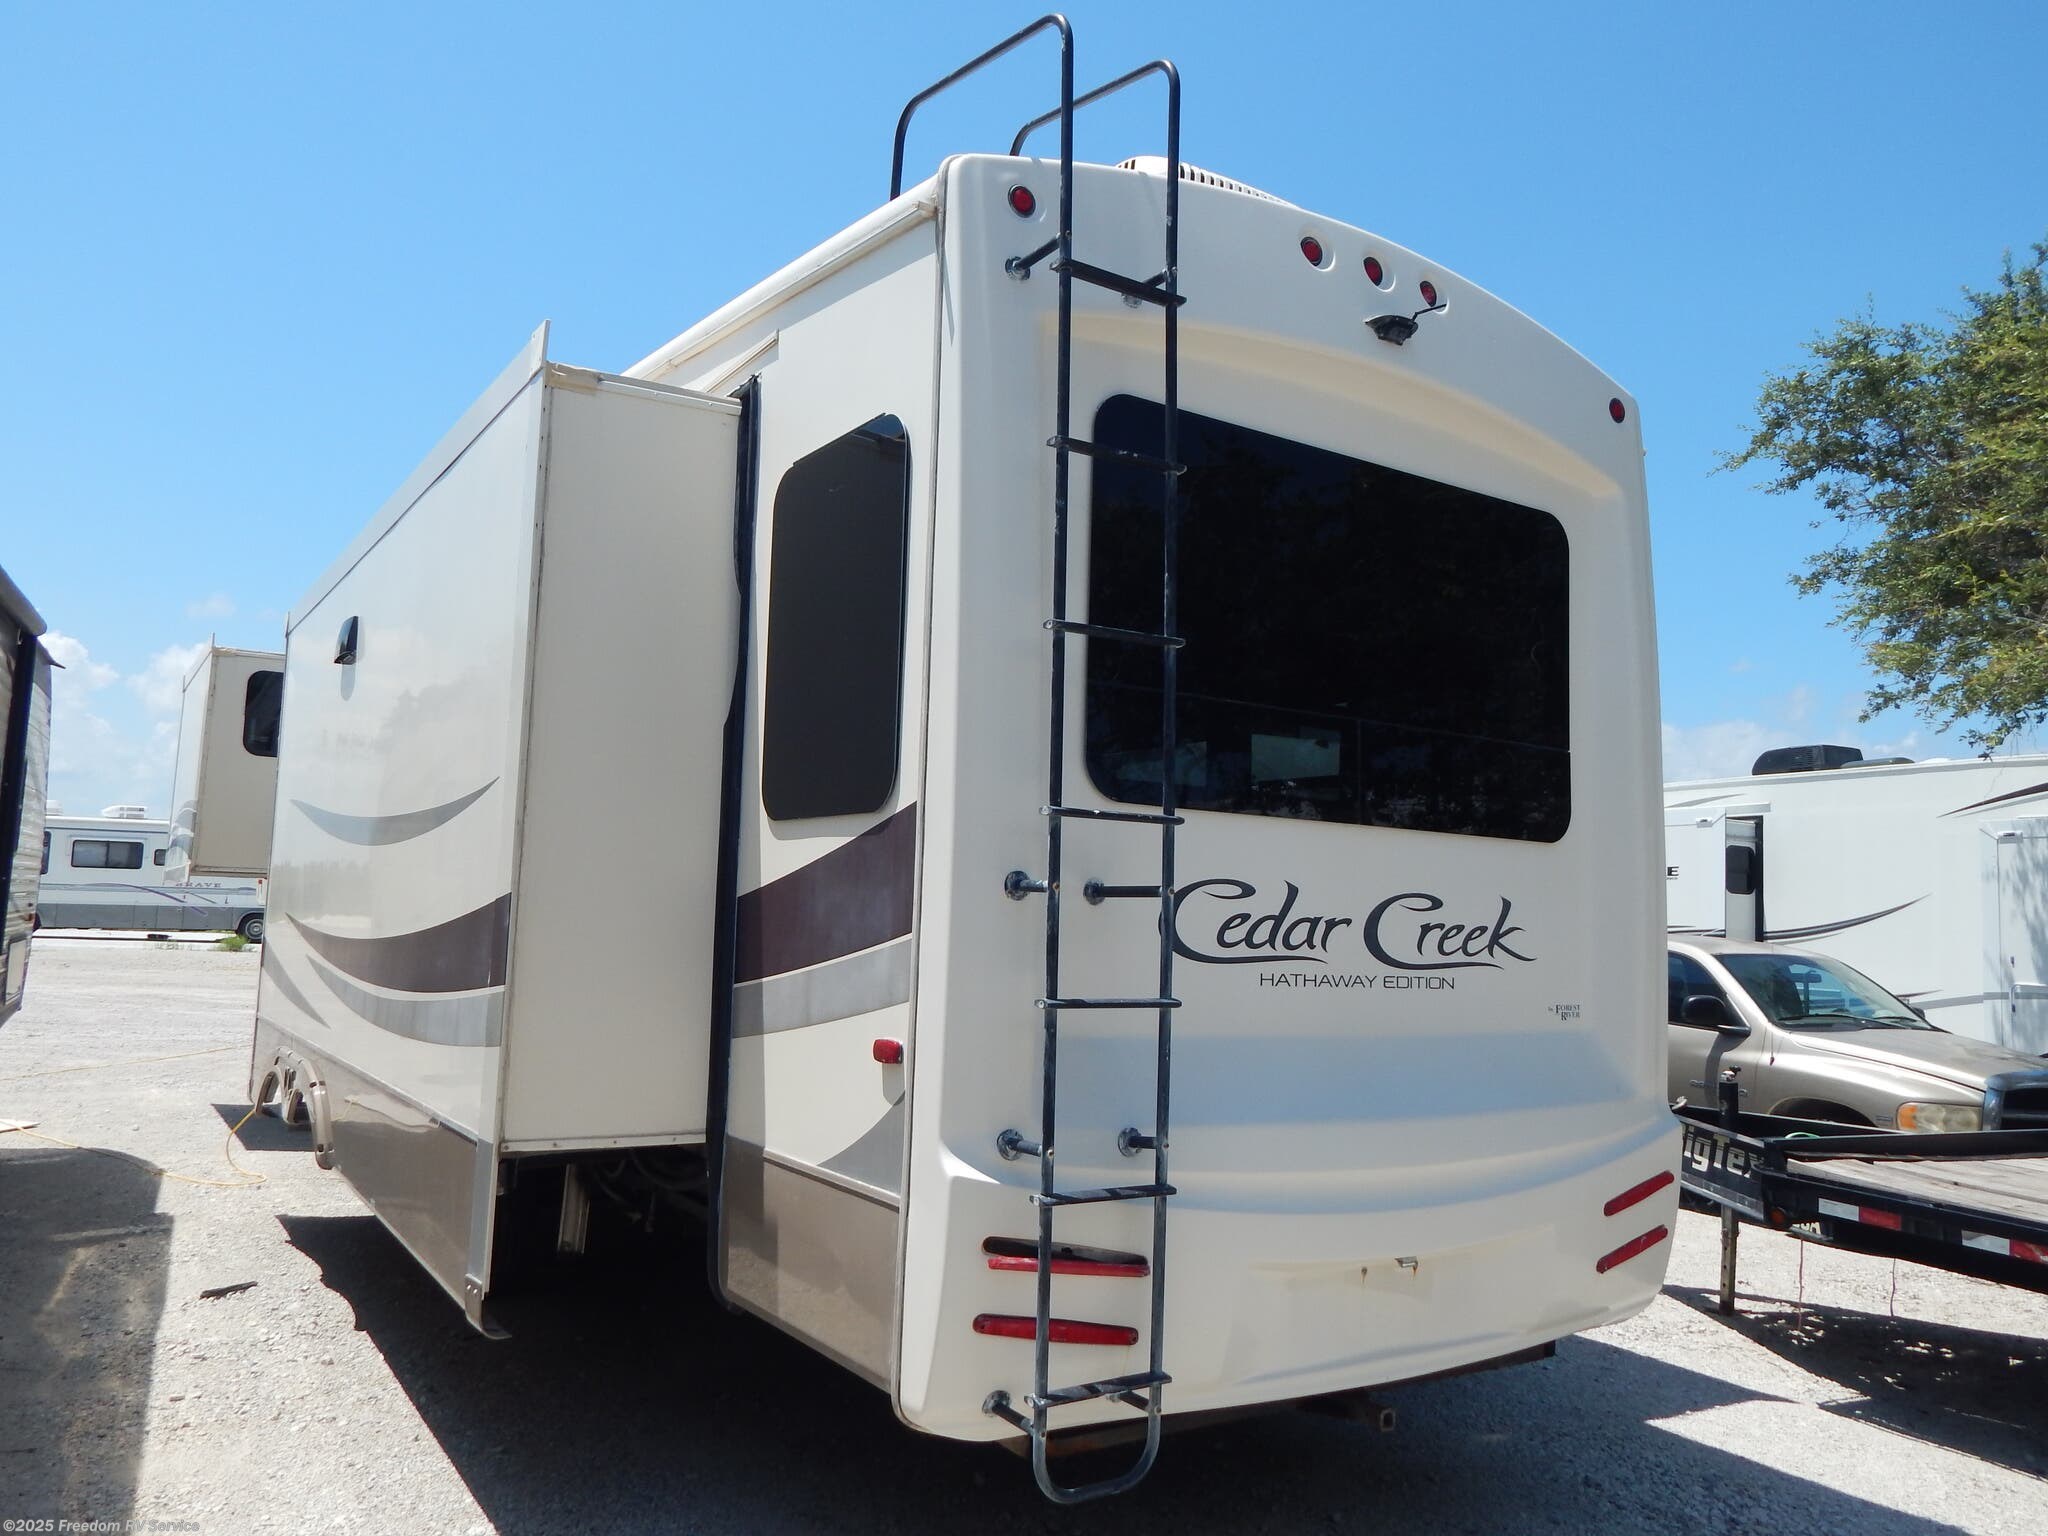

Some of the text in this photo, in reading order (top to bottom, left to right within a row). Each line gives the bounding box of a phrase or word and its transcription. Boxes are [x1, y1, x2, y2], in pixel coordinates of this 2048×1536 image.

[1159, 878, 1538, 970] Cedar Creek
[1259, 972, 1455, 990] HATHAWAY EDITION
[1556, 1004, 1580, 1013] FOREST
